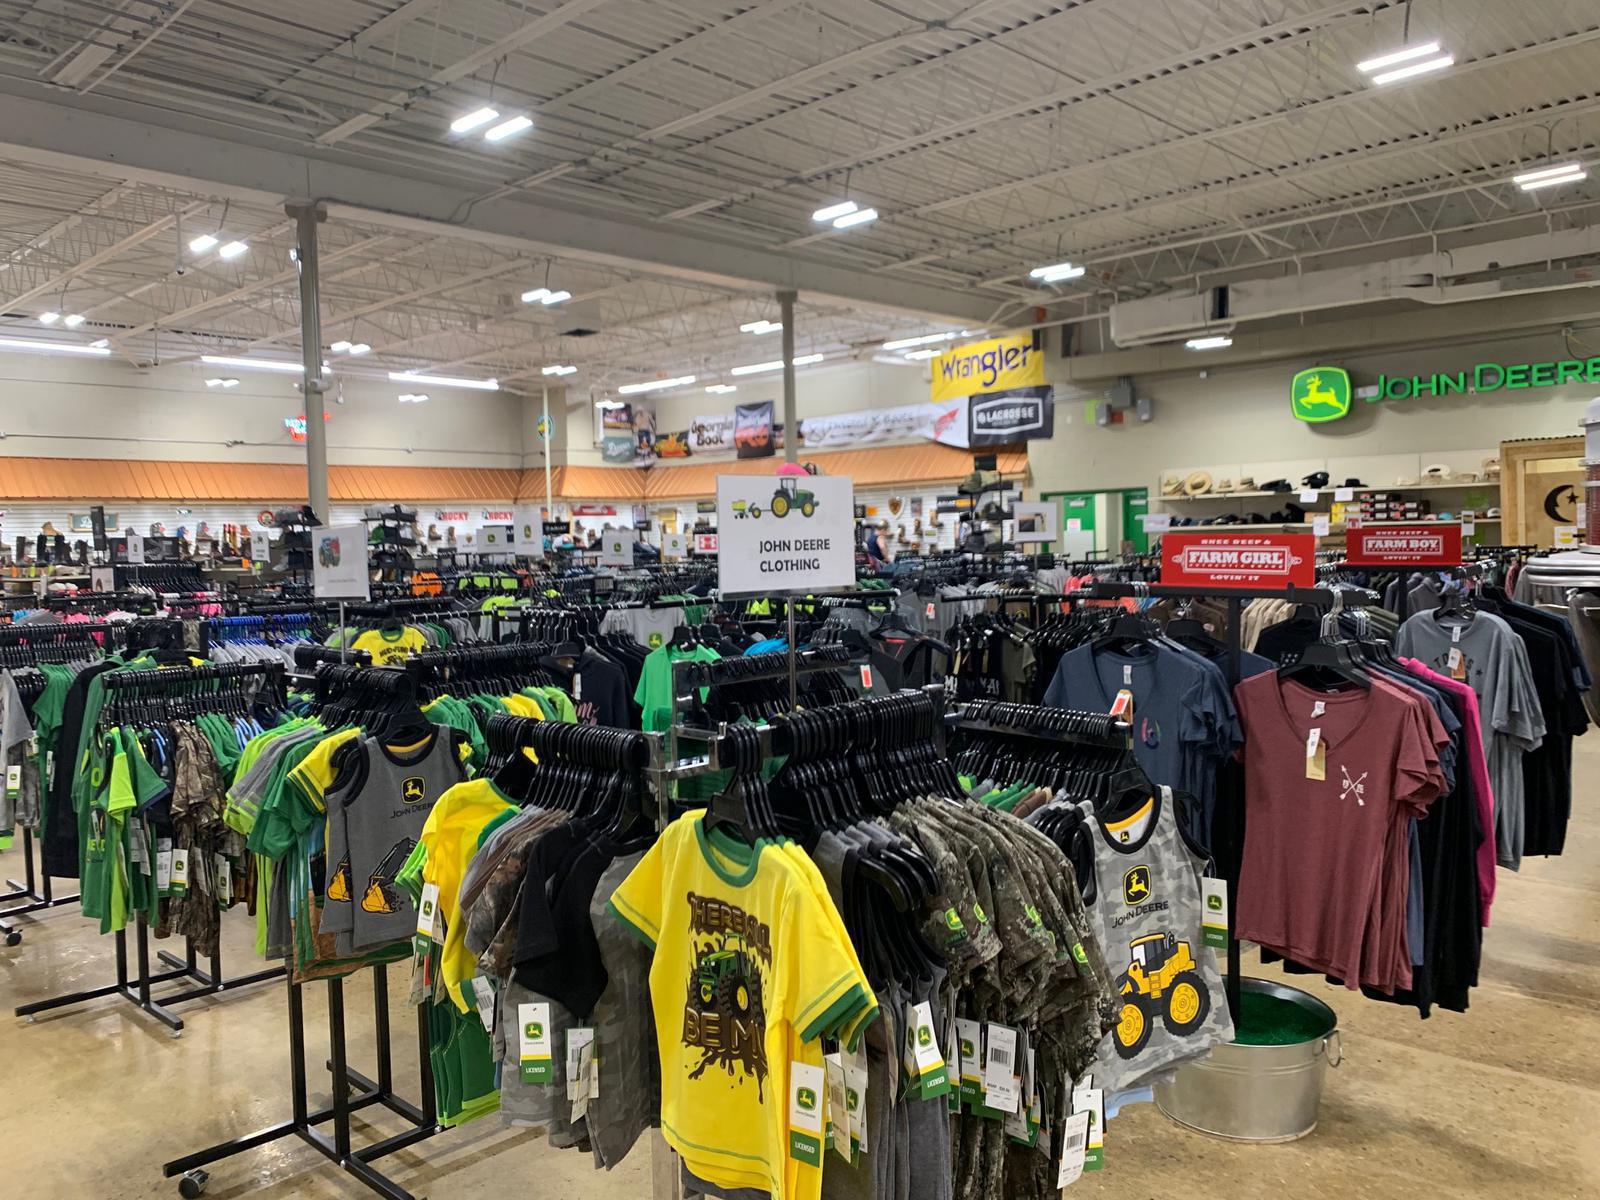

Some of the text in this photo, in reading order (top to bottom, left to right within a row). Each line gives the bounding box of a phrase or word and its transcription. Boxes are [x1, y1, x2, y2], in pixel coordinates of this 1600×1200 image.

[940, 345, 1032, 387] Wrangler
[1365, 356, 1600, 403] JOHN DEERE
[986, 406, 1034, 423] LACROSSE
[760, 538, 830, 554] JOHN DEERE
[1367, 539, 1438, 549] FARM BOY
[760, 558, 820, 573] CLOTHING
[1188, 551, 1284, 564] FARM GIRL
[1112, 900, 1169, 928] JOHN DEERE
[685, 1007, 722, 1049] BE
